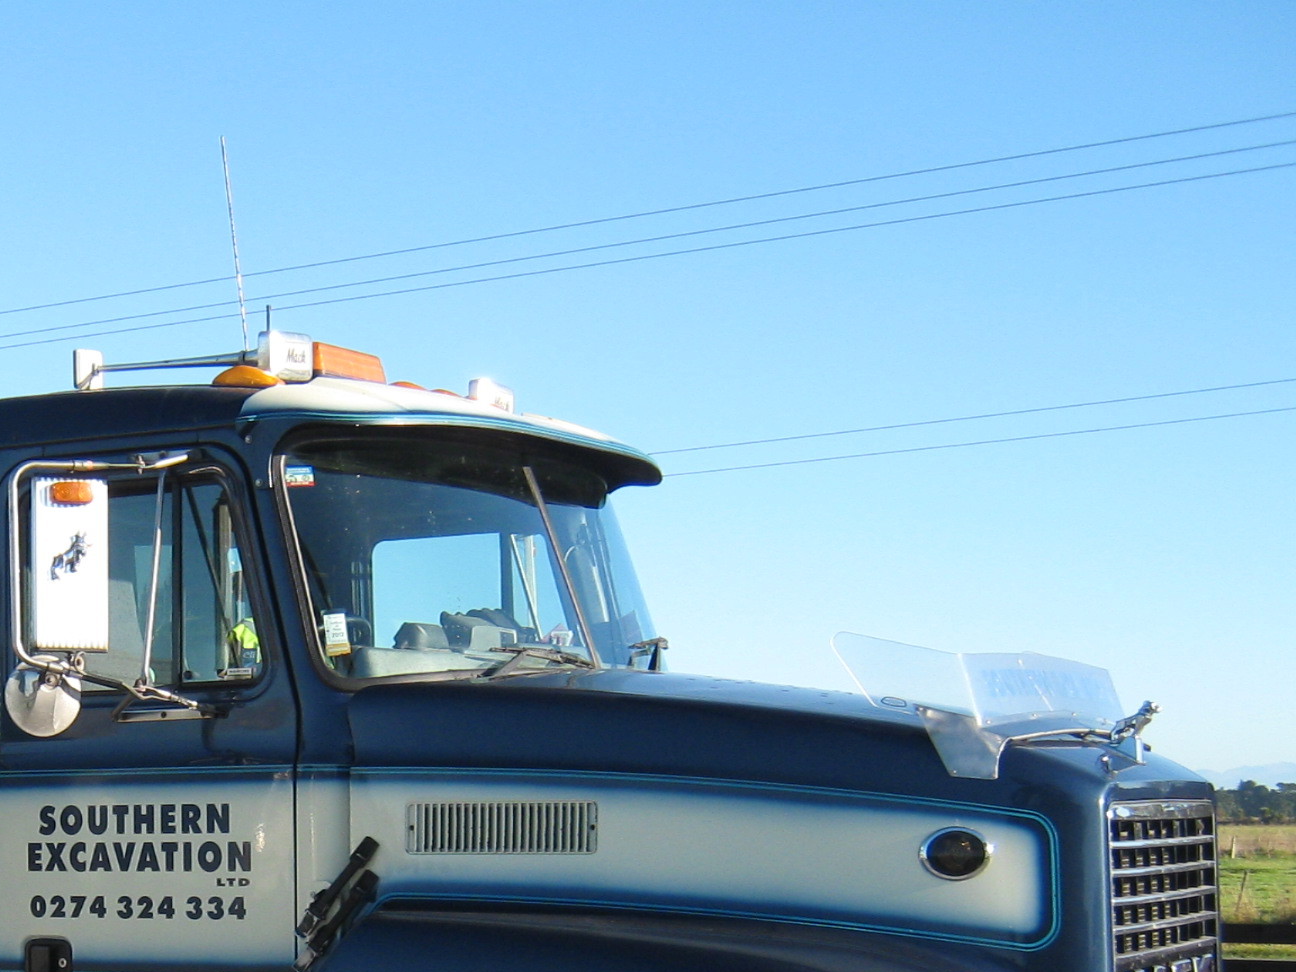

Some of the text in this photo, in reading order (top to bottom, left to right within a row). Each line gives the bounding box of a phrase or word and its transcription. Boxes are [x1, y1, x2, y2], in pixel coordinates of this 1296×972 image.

[39, 803, 230, 836] SOUTHERN
[27, 841, 252, 872] EXCAVATION
[216, 877, 250, 887] LTD
[30, 895, 247, 920] 0274 324 334
